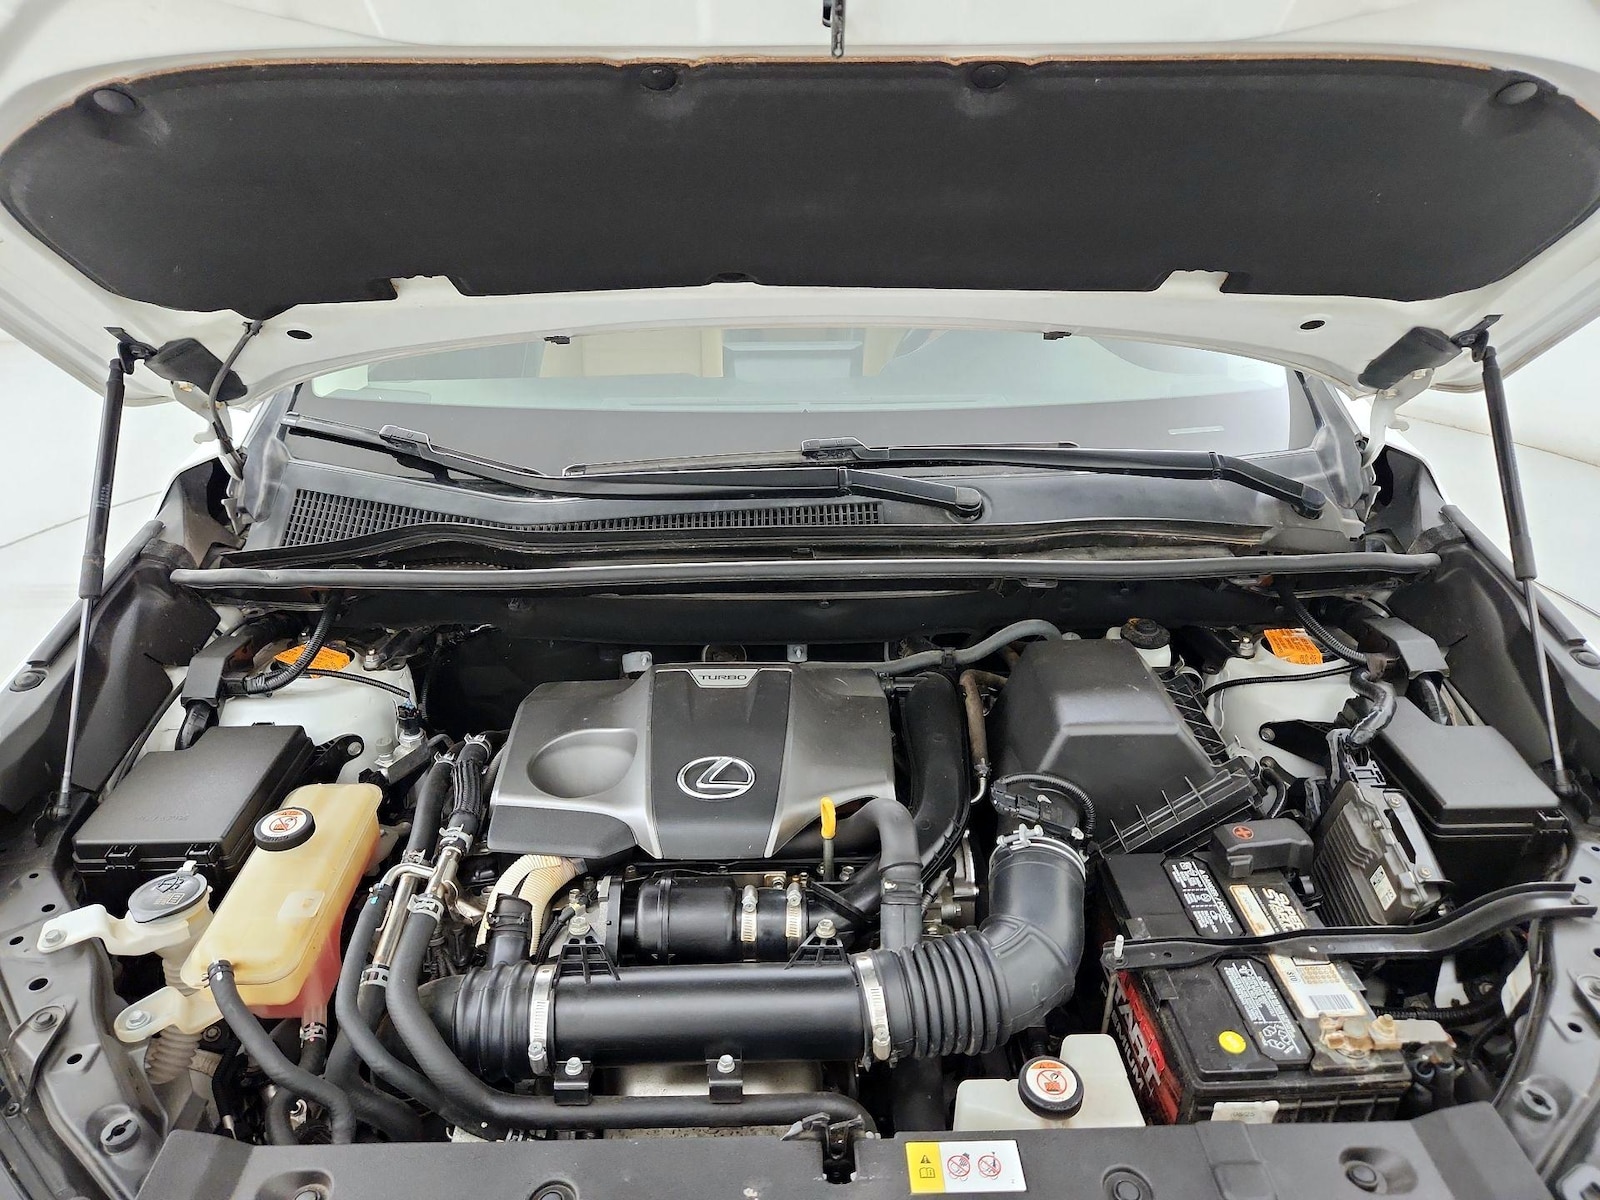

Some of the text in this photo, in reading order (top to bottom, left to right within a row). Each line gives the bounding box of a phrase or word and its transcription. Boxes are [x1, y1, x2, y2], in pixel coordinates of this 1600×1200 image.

[1261, 887, 1291, 932] START
[1275, 892, 1306, 931] SUPER
[1110, 975, 1161, 1087] TART
[1116, 971, 1165, 1077] UPER
